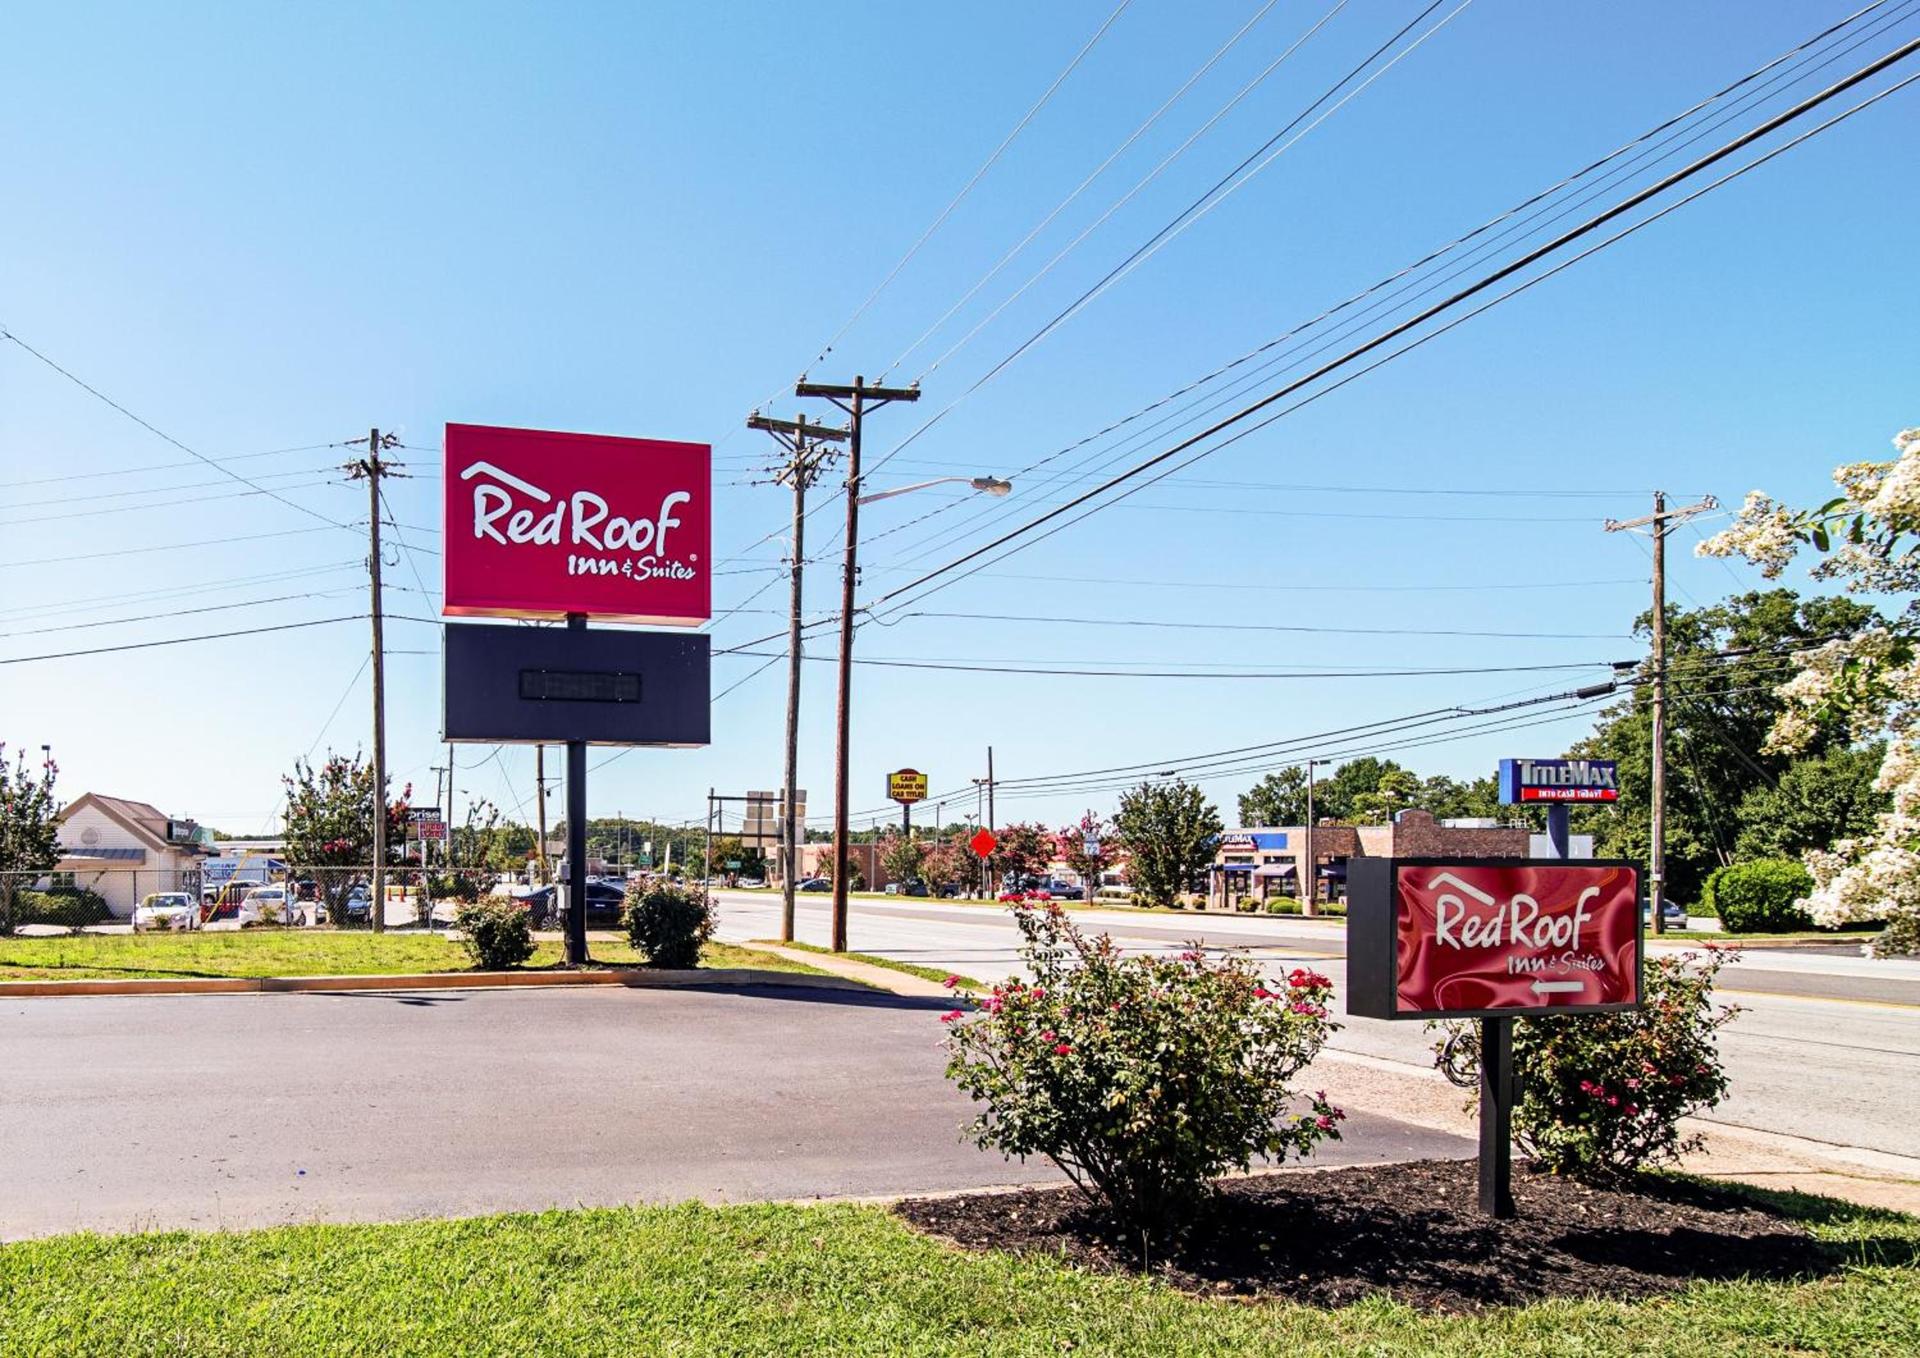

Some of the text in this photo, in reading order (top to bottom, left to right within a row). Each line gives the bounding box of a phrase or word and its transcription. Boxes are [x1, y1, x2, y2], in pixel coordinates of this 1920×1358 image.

[474, 484, 691, 556] Red Roof
[568, 554, 696, 580] Inn & Suites
[408, 810, 440, 820] prise
[1436, 886, 1600, 950] Red Roof
[1508, 956, 1546, 975] Inn
[1560, 950, 1606, 975] Suites
